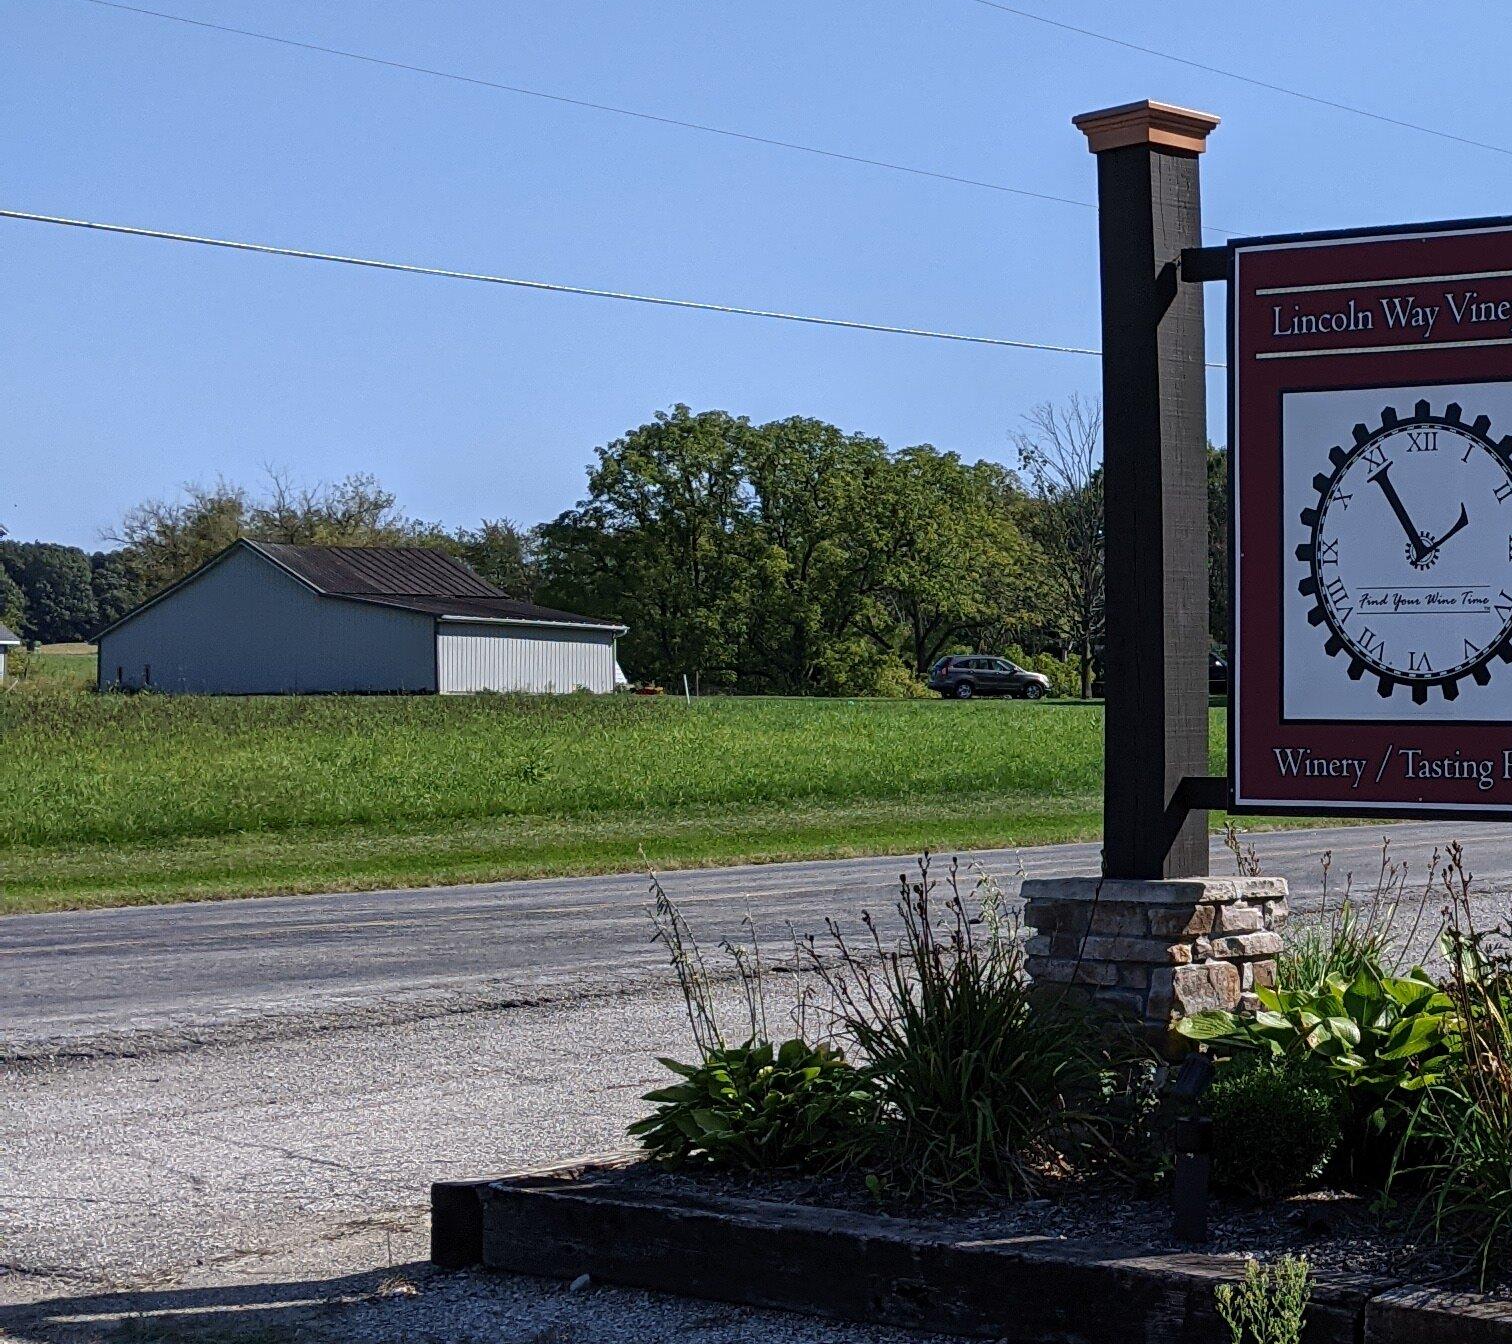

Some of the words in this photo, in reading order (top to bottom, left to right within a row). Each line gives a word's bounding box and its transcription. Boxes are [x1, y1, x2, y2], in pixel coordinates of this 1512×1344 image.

[1273, 300, 1374, 335] Lincoln
[1380, 297, 1439, 338] Way
[1406, 432, 1438, 452] XII
[1461, 443, 1475, 463] I
[1362, 444, 1388, 474] XI
[1333, 486, 1353, 510] X
[1322, 538, 1338, 566] IX
[1326, 576, 1353, 624] VIII
[1359, 593, 1388, 608] Find
[1392, 593, 1420, 611] Your
[1425, 591, 1456, 605] Wine
[1461, 591, 1489, 605] Time
[1356, 627, 1385, 662] VII
[1464, 639, 1481, 660] V
[1408, 651, 1433, 671] VI
[1273, 748, 1367, 788] Winery
[1376, 744, 1393, 783] /
[1399, 748, 1494, 790] Tasting
